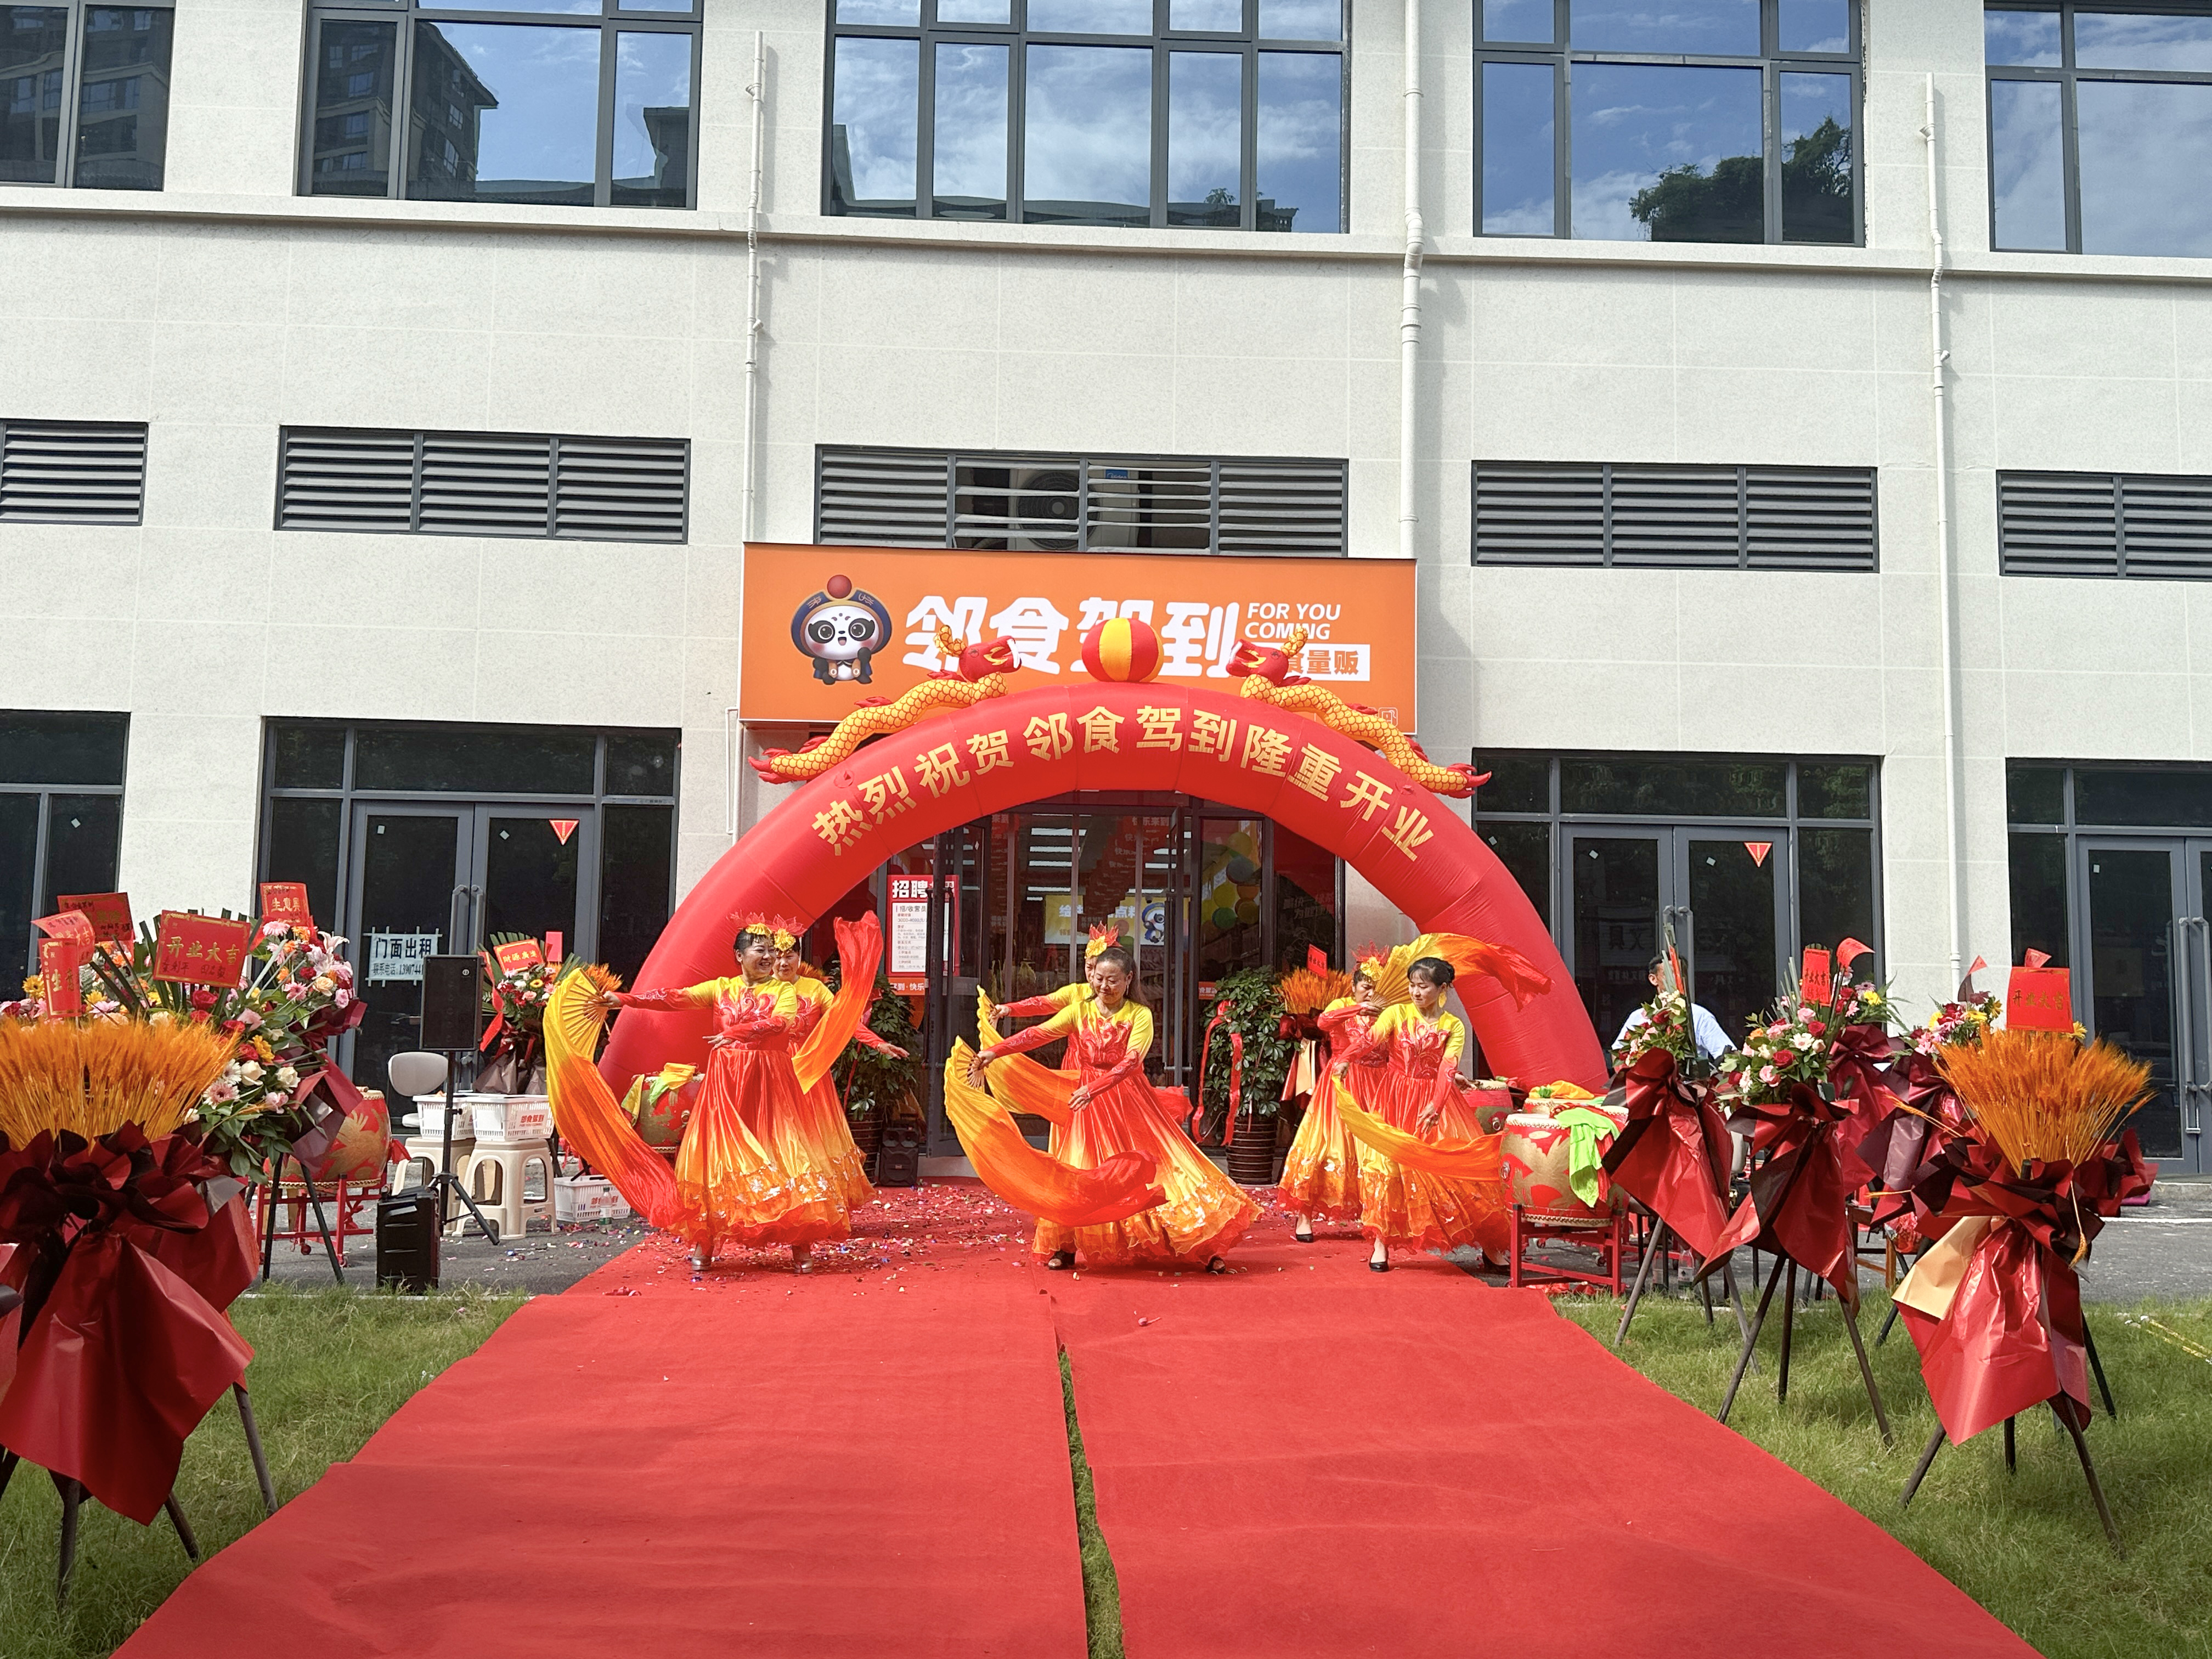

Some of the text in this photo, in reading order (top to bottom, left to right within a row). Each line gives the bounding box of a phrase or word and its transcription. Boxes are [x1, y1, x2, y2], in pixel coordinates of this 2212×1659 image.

[1247, 602, 1341, 620] FOR YOU
[811, 706, 1434, 862] 热烈祝贺邻食驾到隆重开业
[166, 936, 240, 965] 开业大吉
[375, 937, 432, 959] 门面出租
